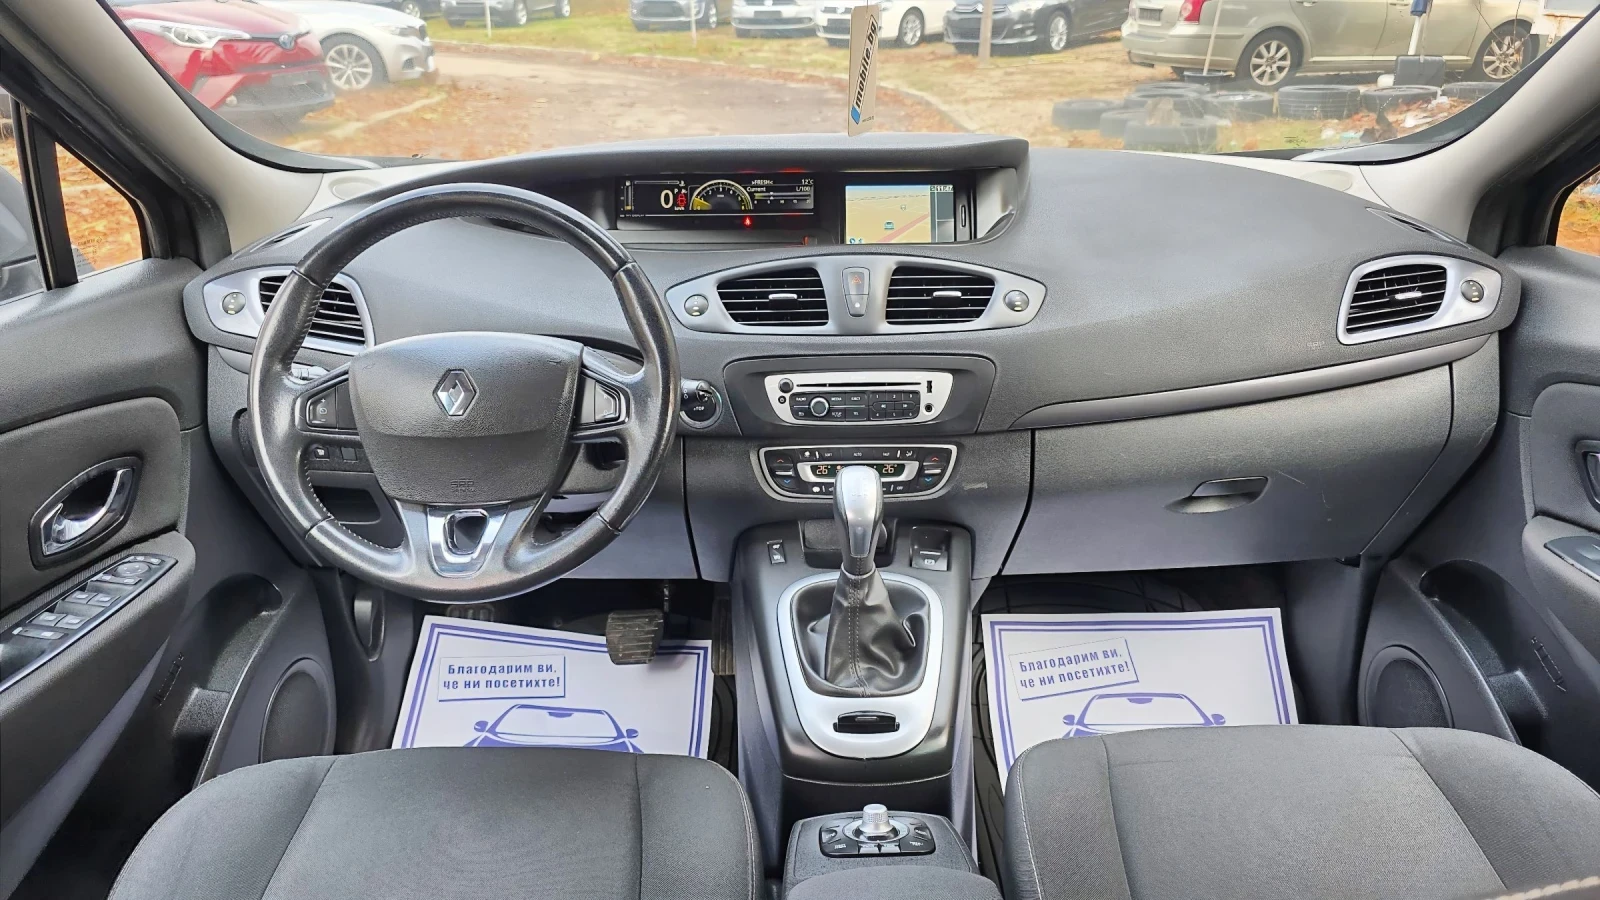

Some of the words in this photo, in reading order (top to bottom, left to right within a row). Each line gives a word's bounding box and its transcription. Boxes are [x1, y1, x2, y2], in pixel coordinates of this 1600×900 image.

[855, 22, 876, 108] mobile.bg
[660, 189, 674, 209] 0
[448, 664, 533, 675] Благодарим
[1018, 651, 1099, 673] Благодарим
[443, 680, 459, 689] че
[464, 680, 480, 689] ни
[485, 676, 560, 689] посетихте!
[1020, 678, 1035, 689] че
[1038, 675, 1055, 686] ни
[1058, 661, 1130, 683] посетихте!
